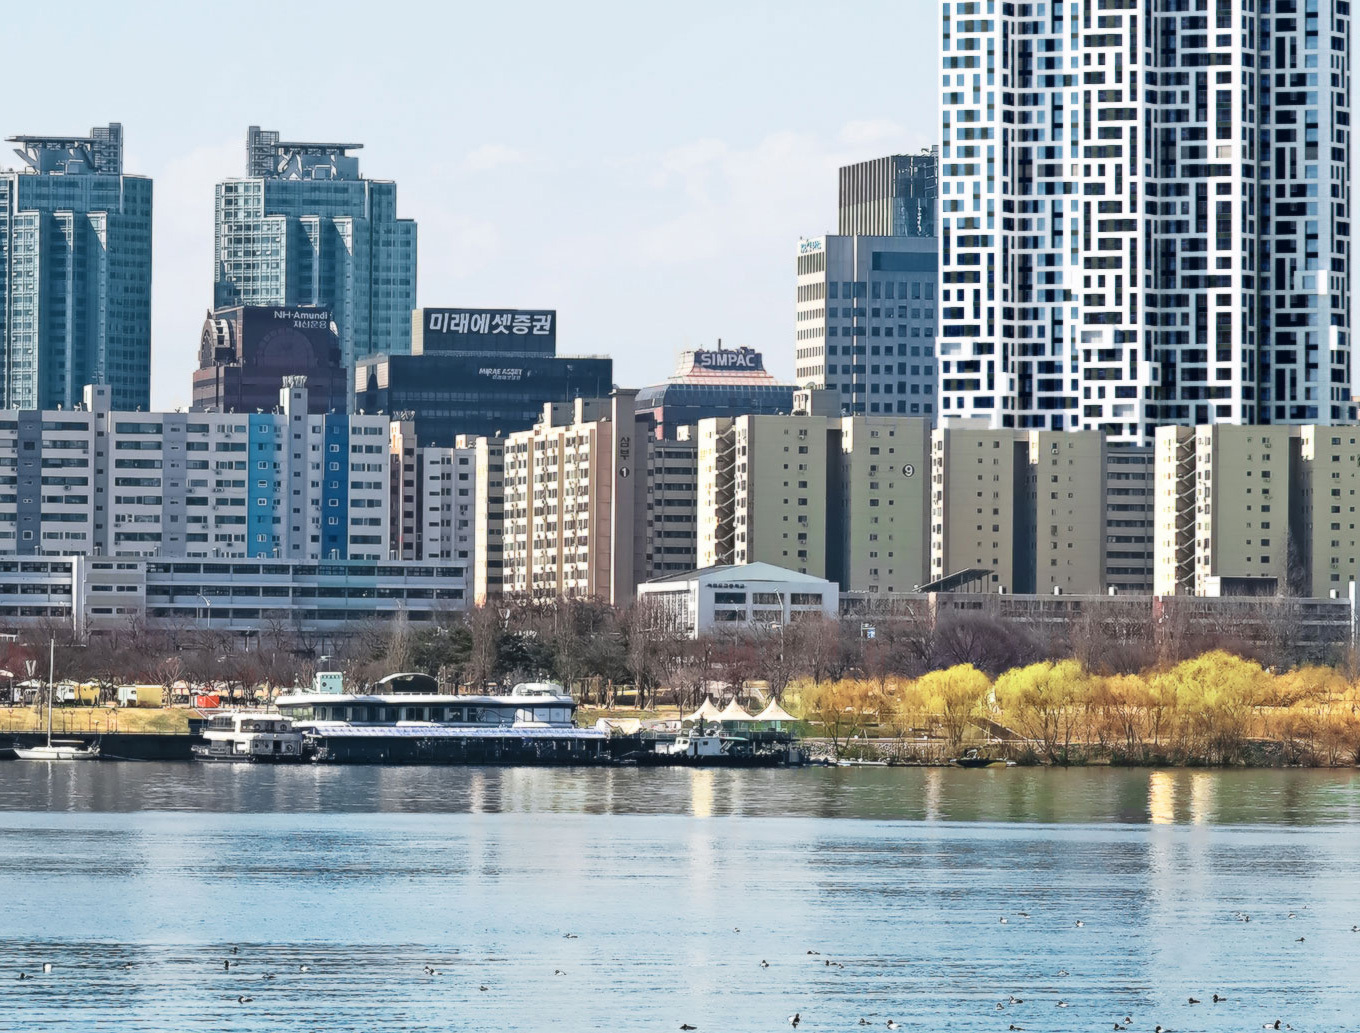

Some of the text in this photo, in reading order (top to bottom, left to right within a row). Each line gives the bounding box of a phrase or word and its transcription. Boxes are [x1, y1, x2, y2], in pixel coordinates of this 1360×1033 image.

[429, 312, 552, 335] 미래에셋증권
[701, 353, 756, 367] SIMPAC
[620, 436, 630, 460] 삼부
[904, 464, 914, 477] 9
